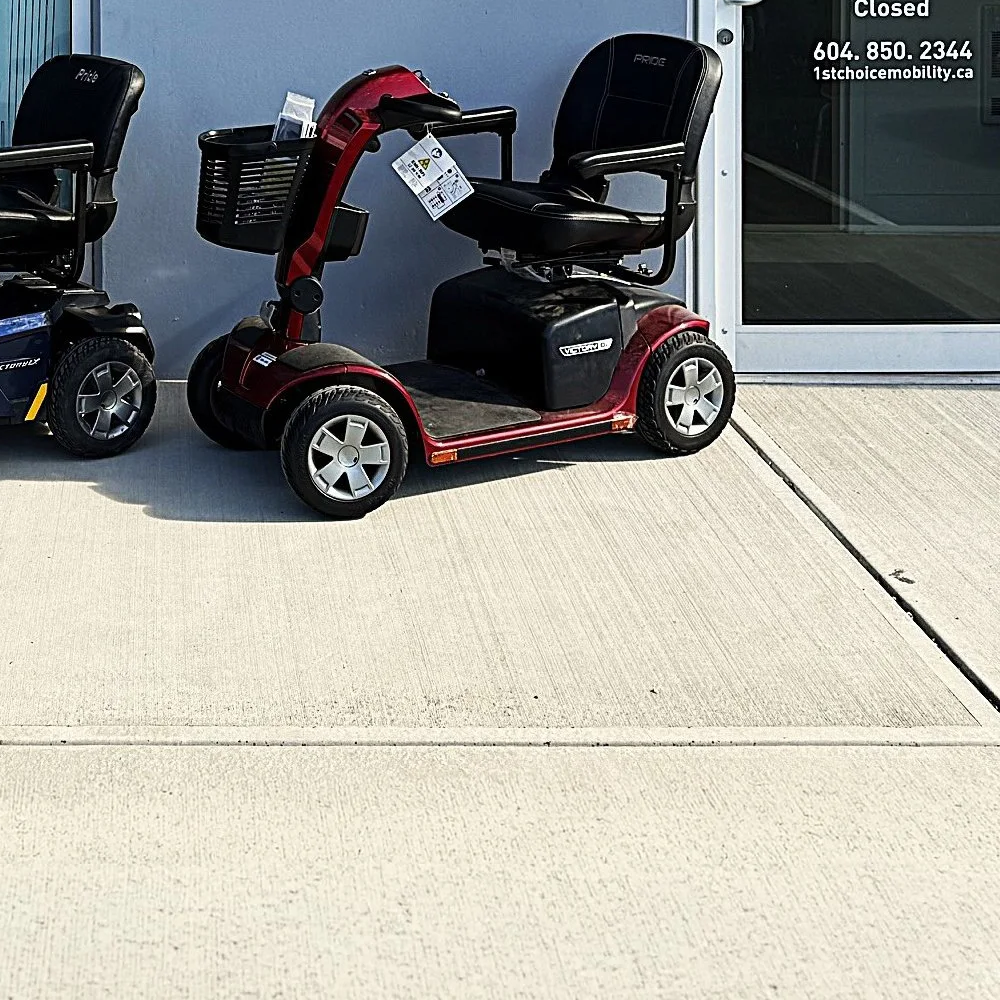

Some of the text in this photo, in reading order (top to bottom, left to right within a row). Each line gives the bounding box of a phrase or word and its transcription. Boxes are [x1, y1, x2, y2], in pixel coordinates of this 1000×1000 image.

[813, 40, 973, 61] 604. 850. 2344
[633, 54, 667, 67] PRIDE
[75, 68, 99, 83] Pride
[813, 65, 974, 82] 1stchoicemobility.ca
